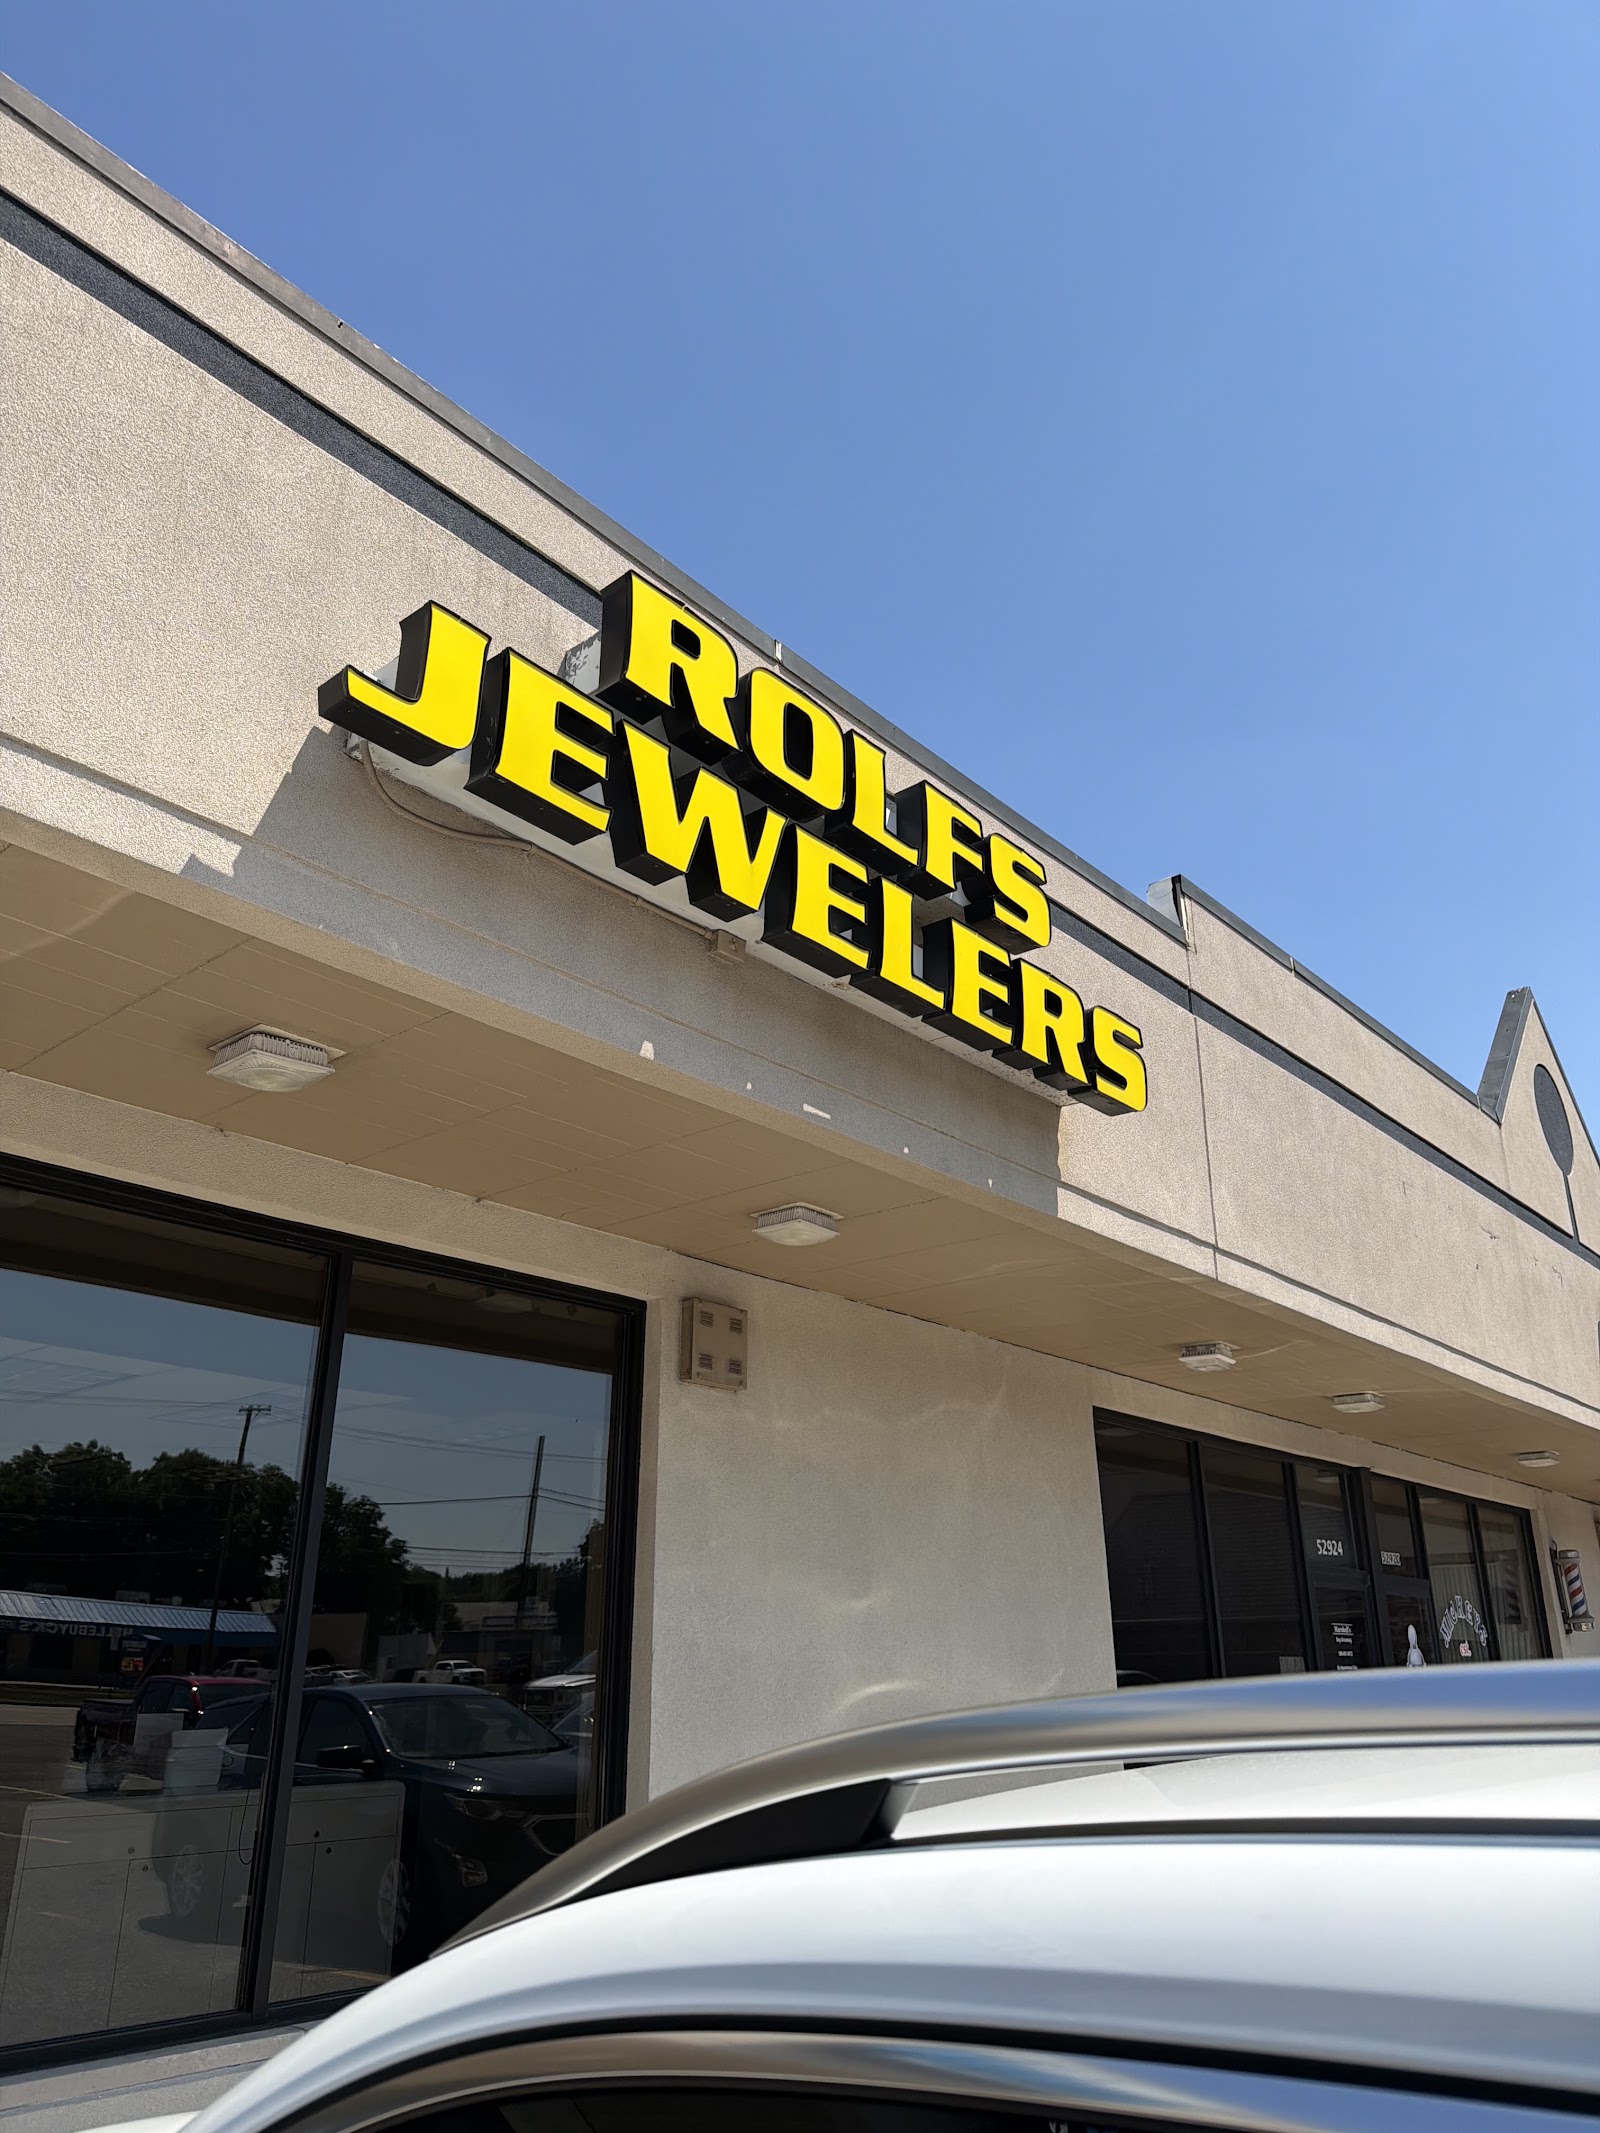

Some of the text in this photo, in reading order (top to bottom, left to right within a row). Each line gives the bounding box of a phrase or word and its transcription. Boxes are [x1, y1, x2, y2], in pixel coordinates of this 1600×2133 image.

[345, 603, 1146, 1112] JEWELERS
[622, 574, 1050, 949] ROLFS
[1316, 1539, 1344, 1556] 52924
